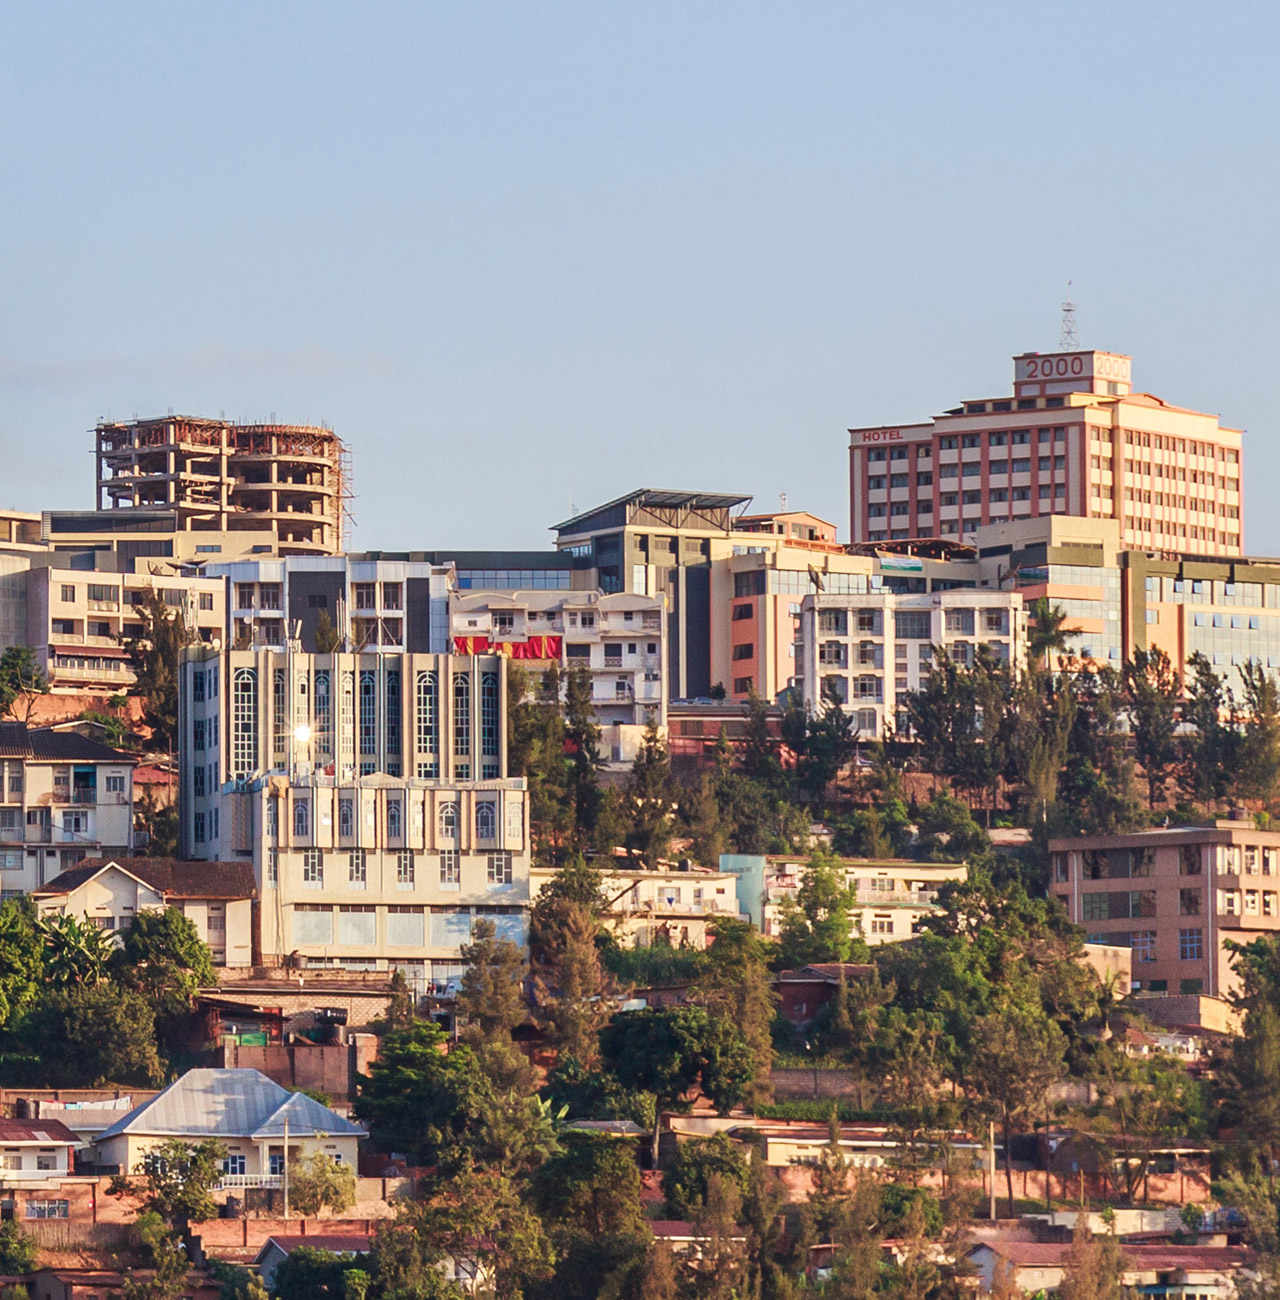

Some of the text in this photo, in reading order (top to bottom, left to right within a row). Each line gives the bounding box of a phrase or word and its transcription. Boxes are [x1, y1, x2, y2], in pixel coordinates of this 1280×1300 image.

[1026, 356, 1083, 379] 2000
[1096, 356, 1128, 379] 2000
[862, 430, 903, 442] HOTEL
